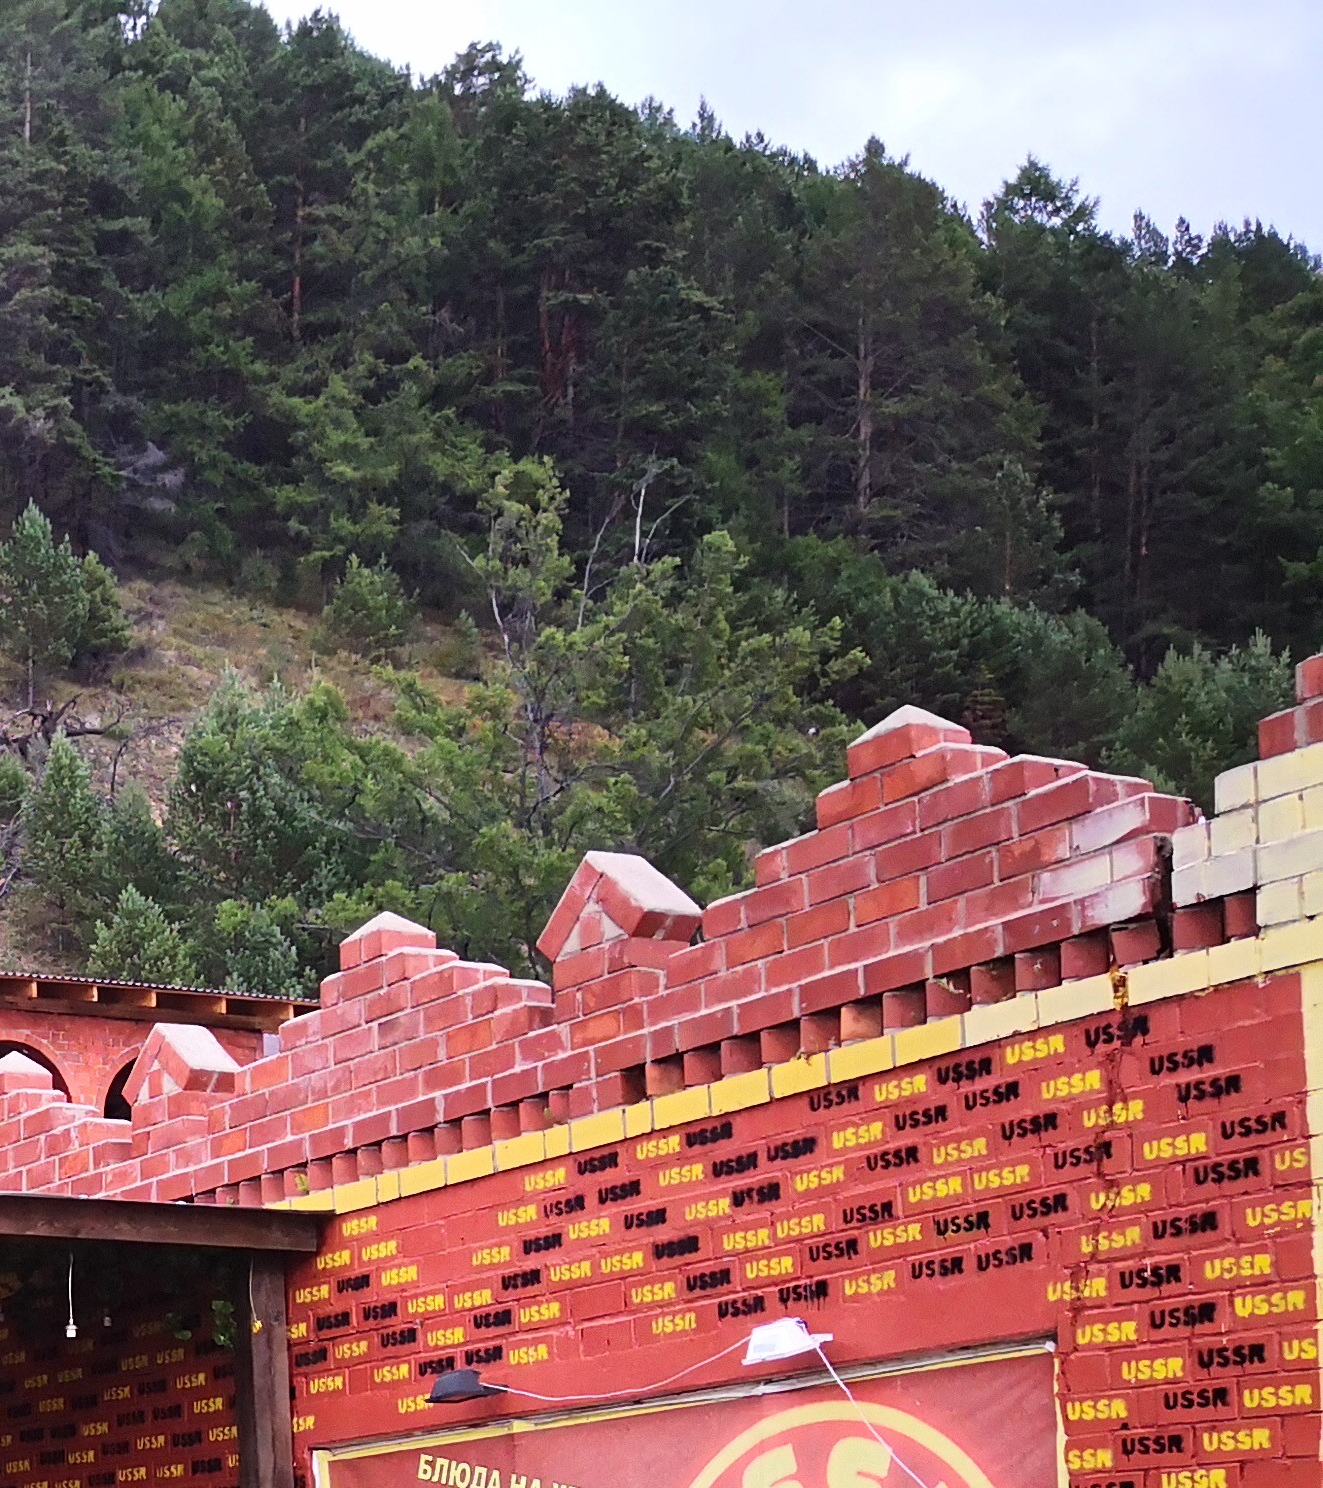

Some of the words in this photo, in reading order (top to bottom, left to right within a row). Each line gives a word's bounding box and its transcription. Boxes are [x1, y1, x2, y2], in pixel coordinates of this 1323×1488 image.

[1005, 1035, 1065, 1065] USSR
[1149, 1045, 1216, 1076] USSR
[937, 1057, 993, 1084] USSR
[875, 1074, 927, 1102] USSR
[964, 1081, 1021, 1110] USSR
[1042, 1070, 1102, 1099] USSR
[1178, 1075, 1243, 1104] USSR
[809, 1084, 861, 1112] USSR
[894, 1106, 949, 1131] USSR
[1001, 1113, 1059, 1141] USSR
[1220, 1112, 1287, 1140] USSR
[831, 1122, 883, 1149] USSR
[1143, 1133, 1208, 1160] USSR
[636, 1135, 680, 1160] USSR
[933, 1138, 987, 1165] USSR
[525, 1168, 566, 1191] USSR
[659, 1164, 704, 1186] USSR
[794, 1166, 844, 1192] USSR
[973, 1164, 1030, 1190] USSR
[1194, 1157, 1261, 1185] USSR
[598, 1181, 641, 1203] USSR
[908, 1180, 963, 1203] USSR
[498, 1205, 538, 1226] USSR
[686, 1198, 730, 1220] USSR
[1011, 1193, 1068, 1221] USSR
[1246, 1200, 1313, 1227] USSR
[342, 1216, 377, 1237] USSR
[568, 1218, 610, 1240] USSR
[776, 1214, 826, 1237] USSR
[869, 1224, 922, 1248] USSR
[361, 1240, 397, 1260] USSR
[723, 1231, 770, 1250] USSR
[317, 1251, 350, 1269] USSR
[472, 1247, 510, 1265] USSR
[601, 1252, 644, 1273] USSR
[746, 1256, 793, 1279] USSR
[911, 1256, 964, 1279] USSR
[977, 1243, 1034, 1271] USSR
[1204, 1254, 1271, 1280] USSR
[381, 1265, 418, 1286] USSR
[550, 1260, 592, 1281] USSR
[631, 1282, 676, 1303] USSR
[844, 1271, 895, 1296] USSR
[408, 1293, 446, 1313] USSR
[454, 1289, 491, 1309] USSR
[1234, 1290, 1306, 1318] USSR
[520, 1302, 561, 1323] USSR
[652, 1314, 696, 1334] USSR
[1150, 1302, 1218, 1329] USSR
[427, 1328, 465, 1346] USSR
[1076, 1321, 1137, 1345] USSR
[509, 1344, 549, 1365] USSR
[1197, 1344, 1267, 1369] USSR
[374, 1364, 409, 1382] USSR
[1122, 1358, 1183, 1380] USSR
[177, 1373, 206, 1389] USSR
[195, 1398, 222, 1412] USSR
[1164, 1388, 1229, 1410] USSR
[1243, 1384, 1312, 1408] USSR
[1067, 1399, 1128, 1420] USSR
[83, 1423, 109, 1437] USSR
[1203, 1428, 1271, 1452] USSR
[137, 1435, 165, 1449] USSR
[1122, 1435, 1184, 1455] USSR
[68, 1450, 95, 1464] USSR
[118, 1467, 147, 1482] USSR
